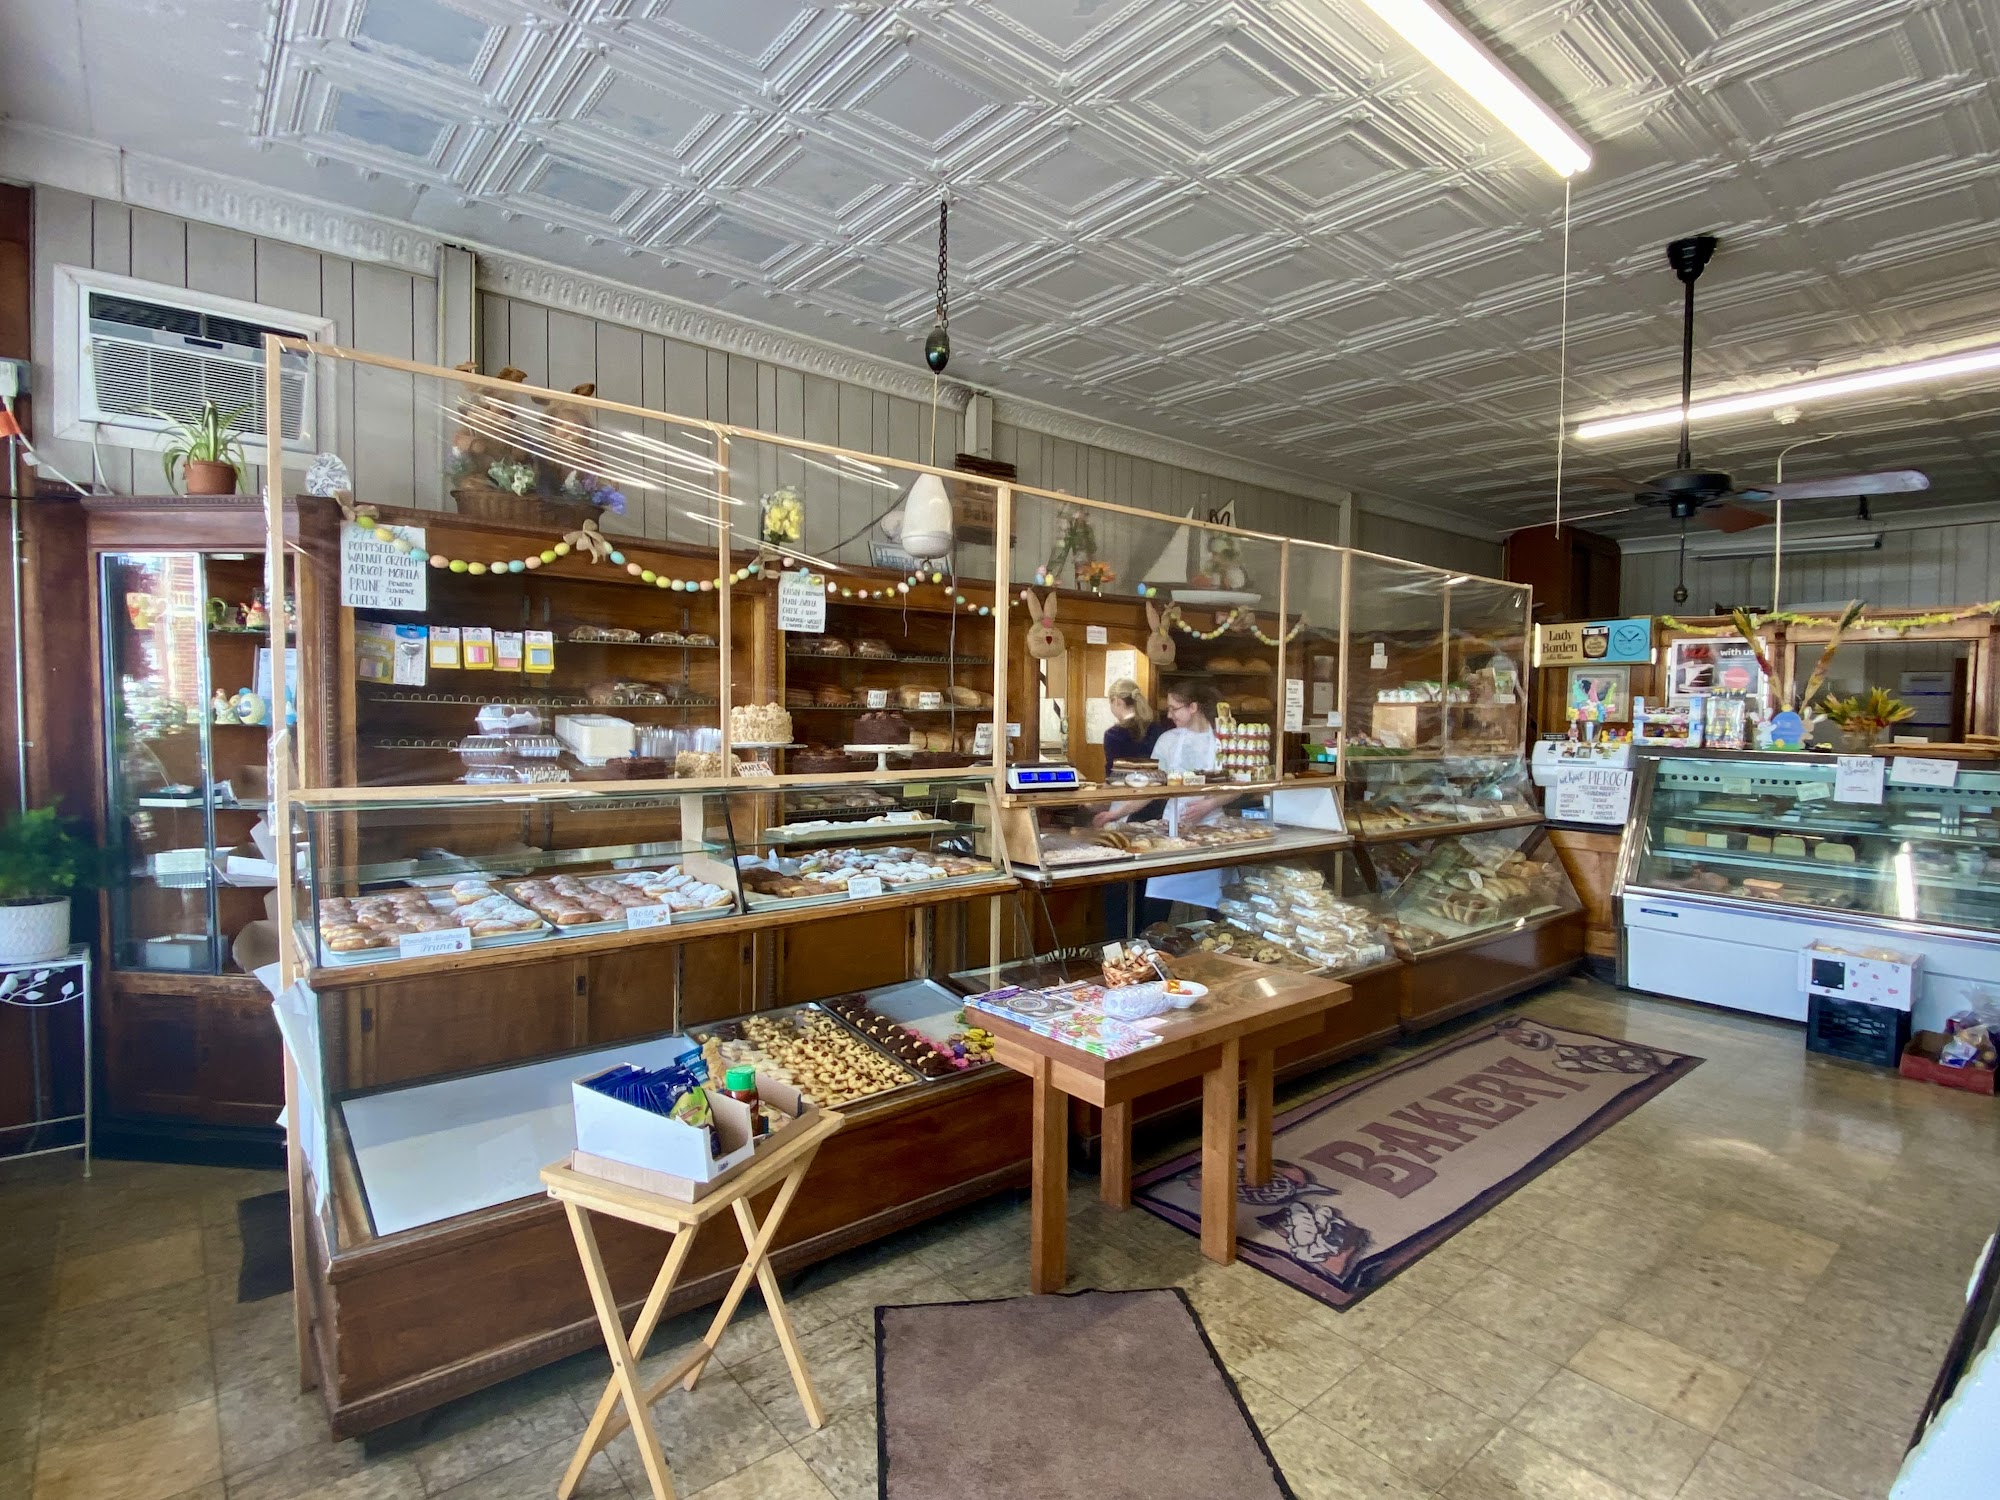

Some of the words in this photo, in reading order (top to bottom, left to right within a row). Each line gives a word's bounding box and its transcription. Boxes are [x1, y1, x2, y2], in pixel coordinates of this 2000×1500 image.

[348, 541, 396, 554] POPPYSEED
[347, 552, 382, 564] WALNUT
[348, 564, 383, 576] APRICOT
[388, 568, 420, 580] MORELA
[349, 577, 380, 592] PRUNE
[349, 593, 380, 606] CHEESE
[388, 596, 404, 607] SER
[1549, 630, 1573, 642] Lady
[1542, 644, 1578, 654] Borden
[1720, 648, 1741, 656] with
[1589, 771, 1628, 786] PIEROGI
[1301, 1056, 1591, 1199] BAKERY
